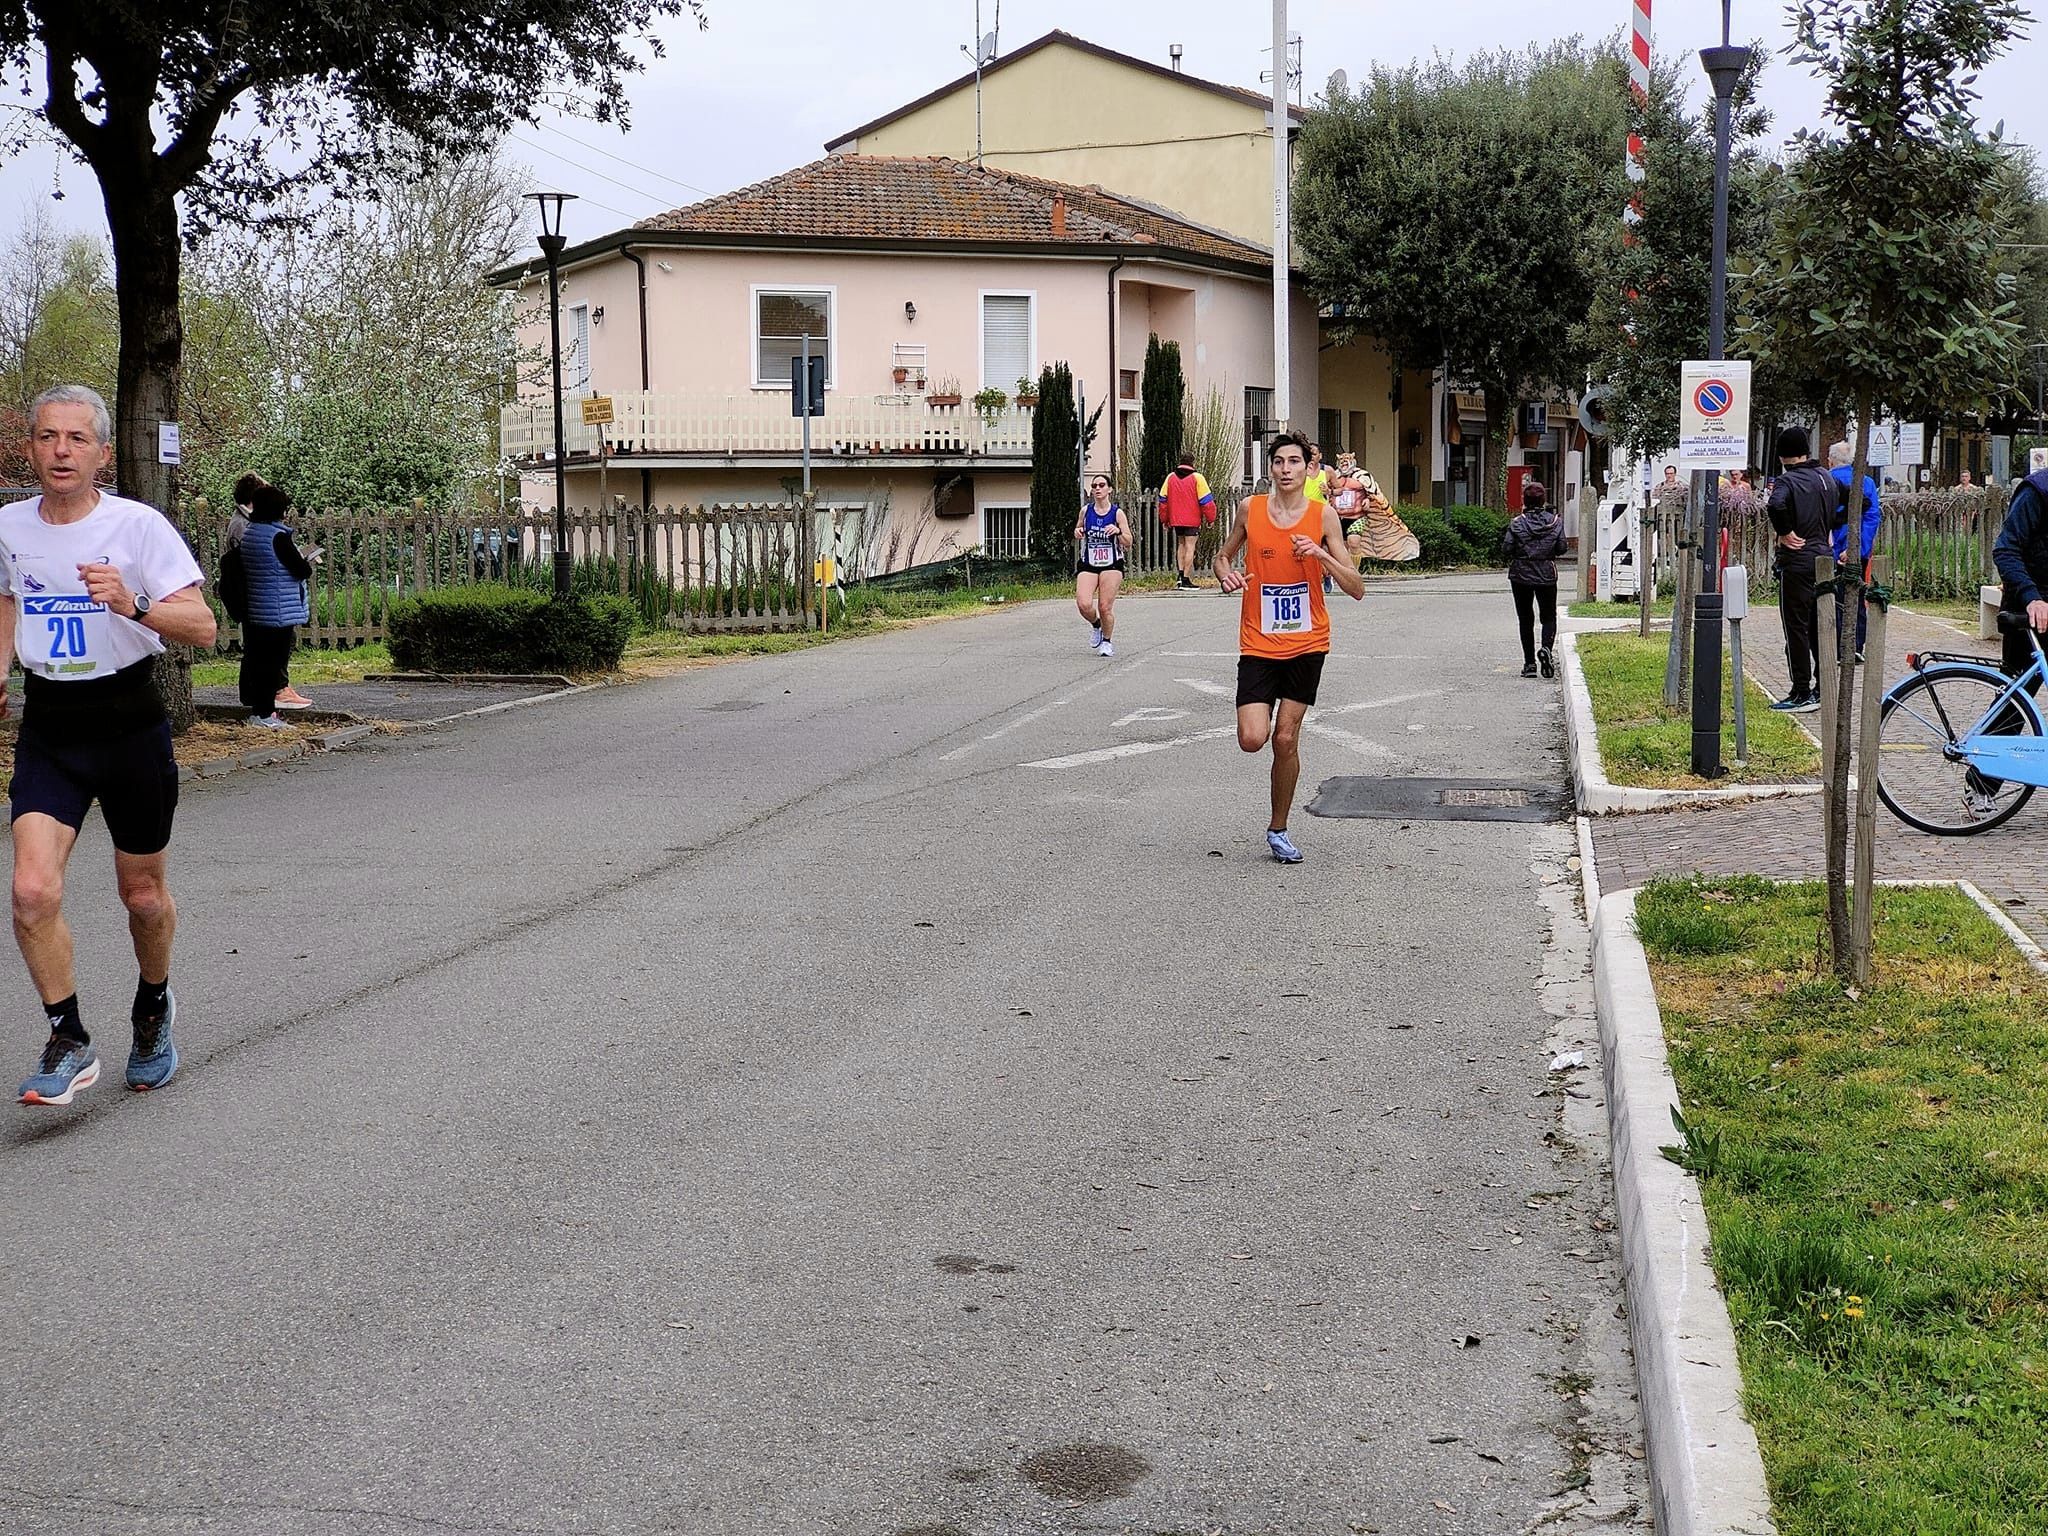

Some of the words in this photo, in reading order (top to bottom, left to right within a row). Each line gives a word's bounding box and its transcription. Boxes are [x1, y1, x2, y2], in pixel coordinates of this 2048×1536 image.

[1093, 549, 1108, 560] 203
[1272, 596, 1301, 620] 183
[47, 616, 87, 658] 20
